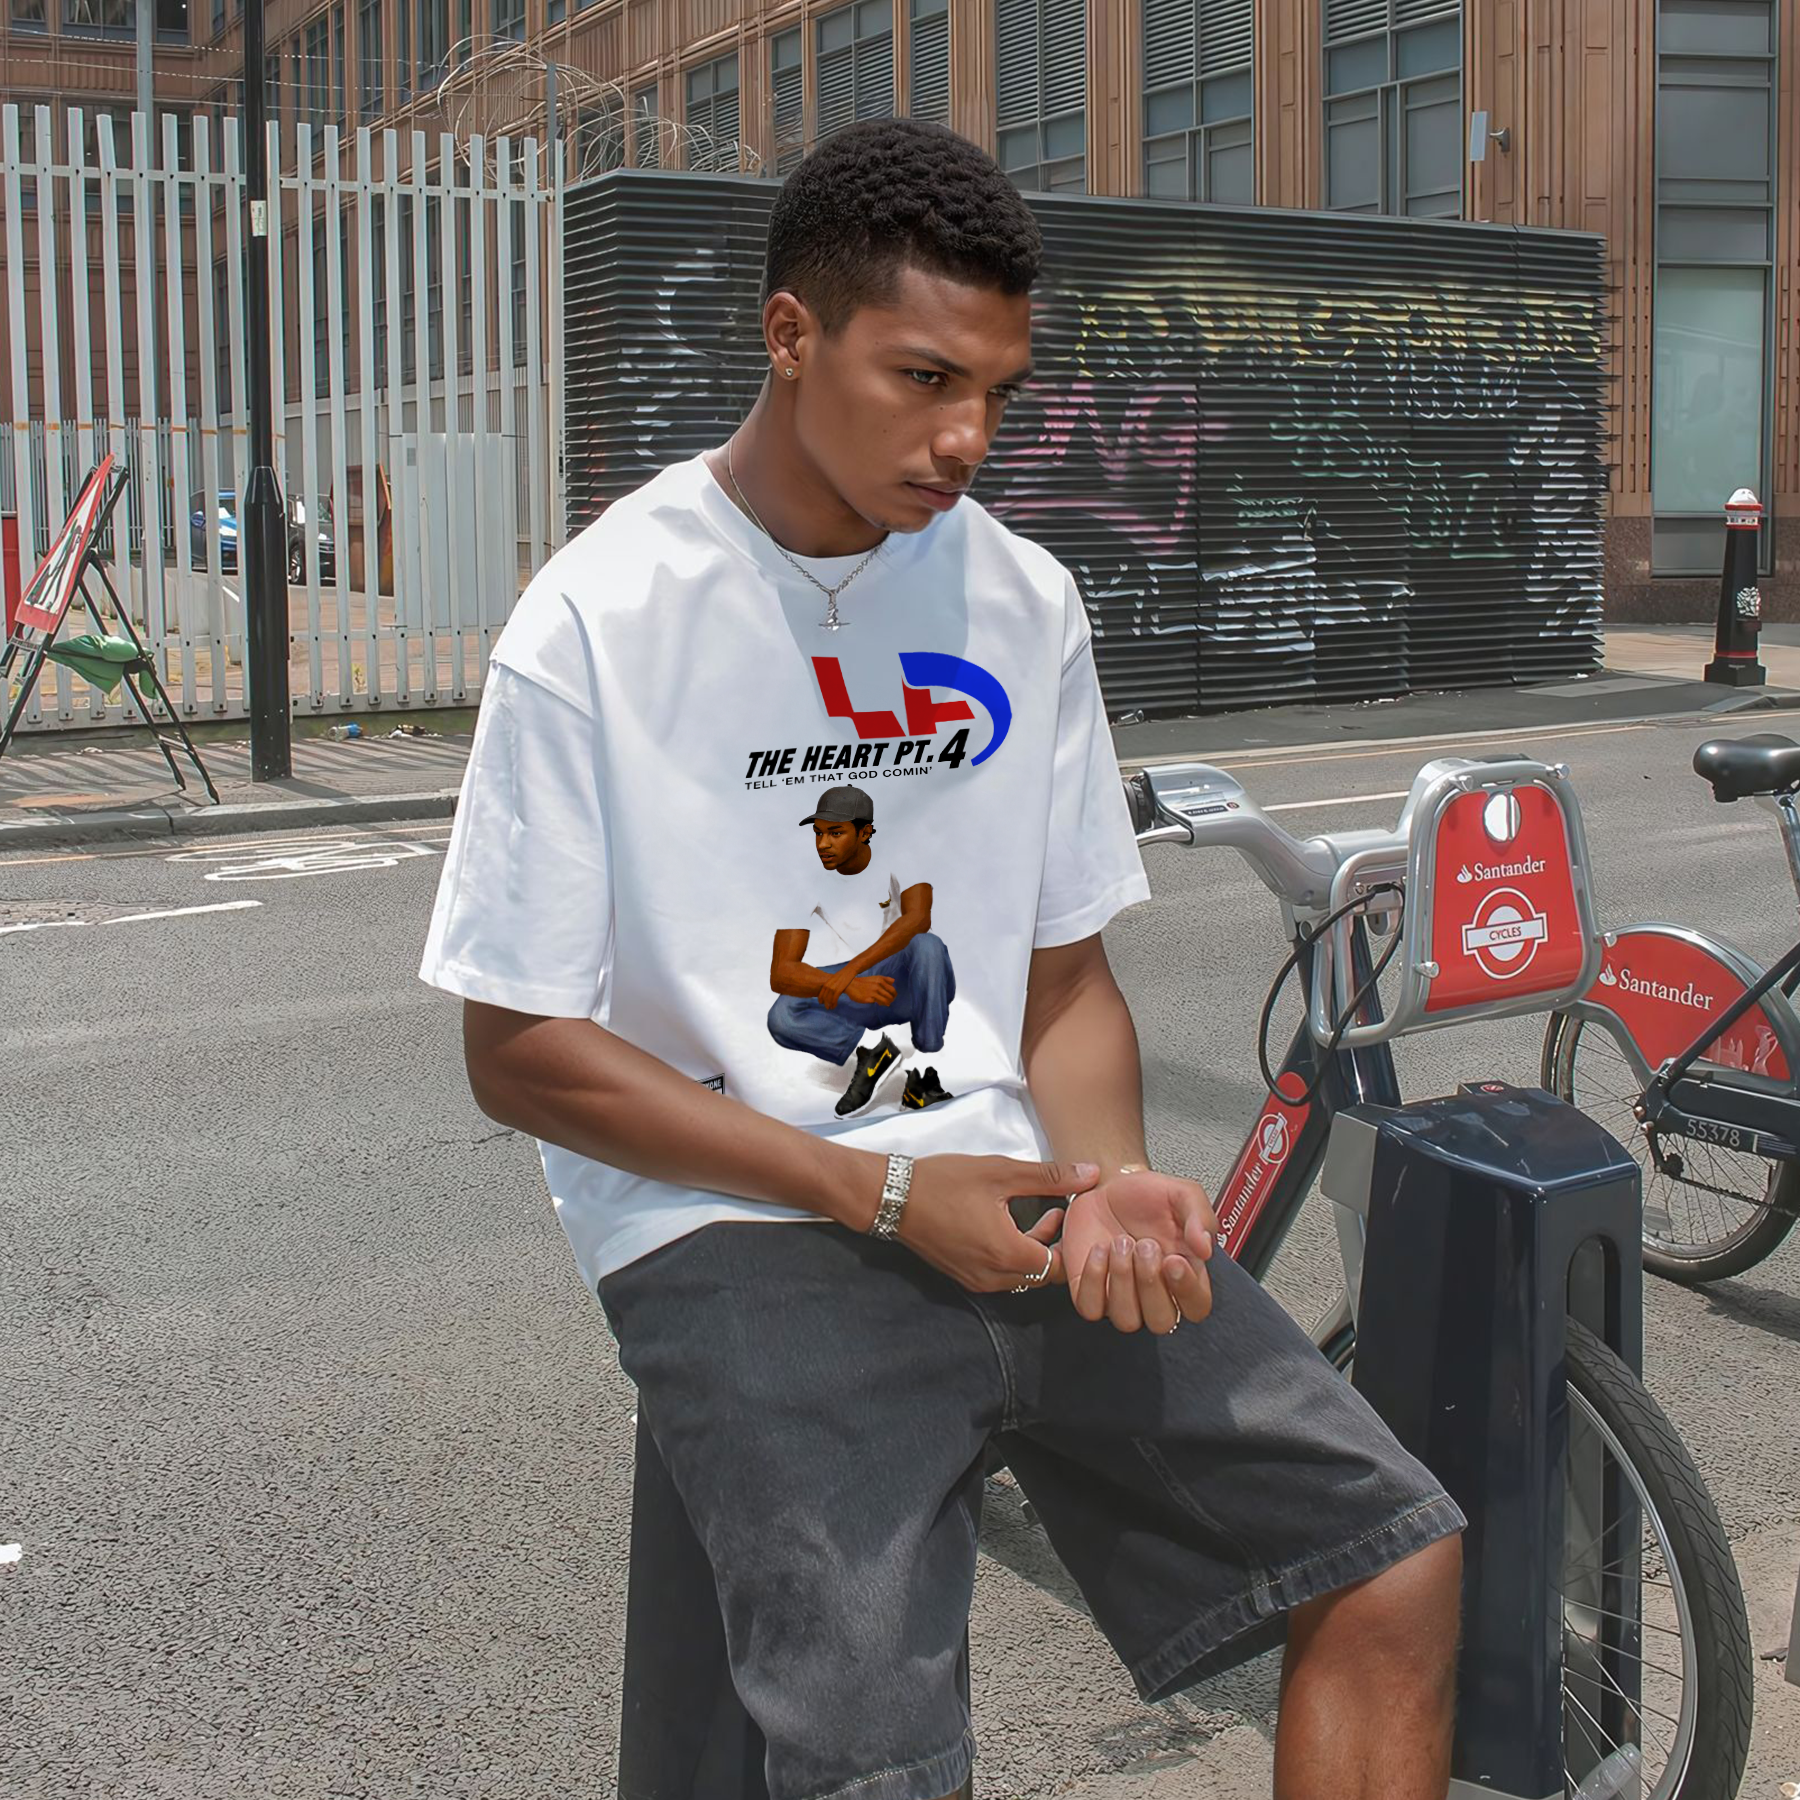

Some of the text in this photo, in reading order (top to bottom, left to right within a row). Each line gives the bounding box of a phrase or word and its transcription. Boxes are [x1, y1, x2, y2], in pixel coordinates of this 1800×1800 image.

[745, 728, 970, 778] THE HEART PT. 4
[745, 779, 777, 790] TELL
[810, 772, 844, 783] THAT
[848, 770, 878, 781] GOD
[1474, 855, 1546, 882] Santander
[1489, 926, 1522, 941] CYCLES
[1619, 968, 1714, 1010] Santander
[1686, 1119, 1741, 1147] 55378
[1221, 1162, 1264, 1236] Santander
